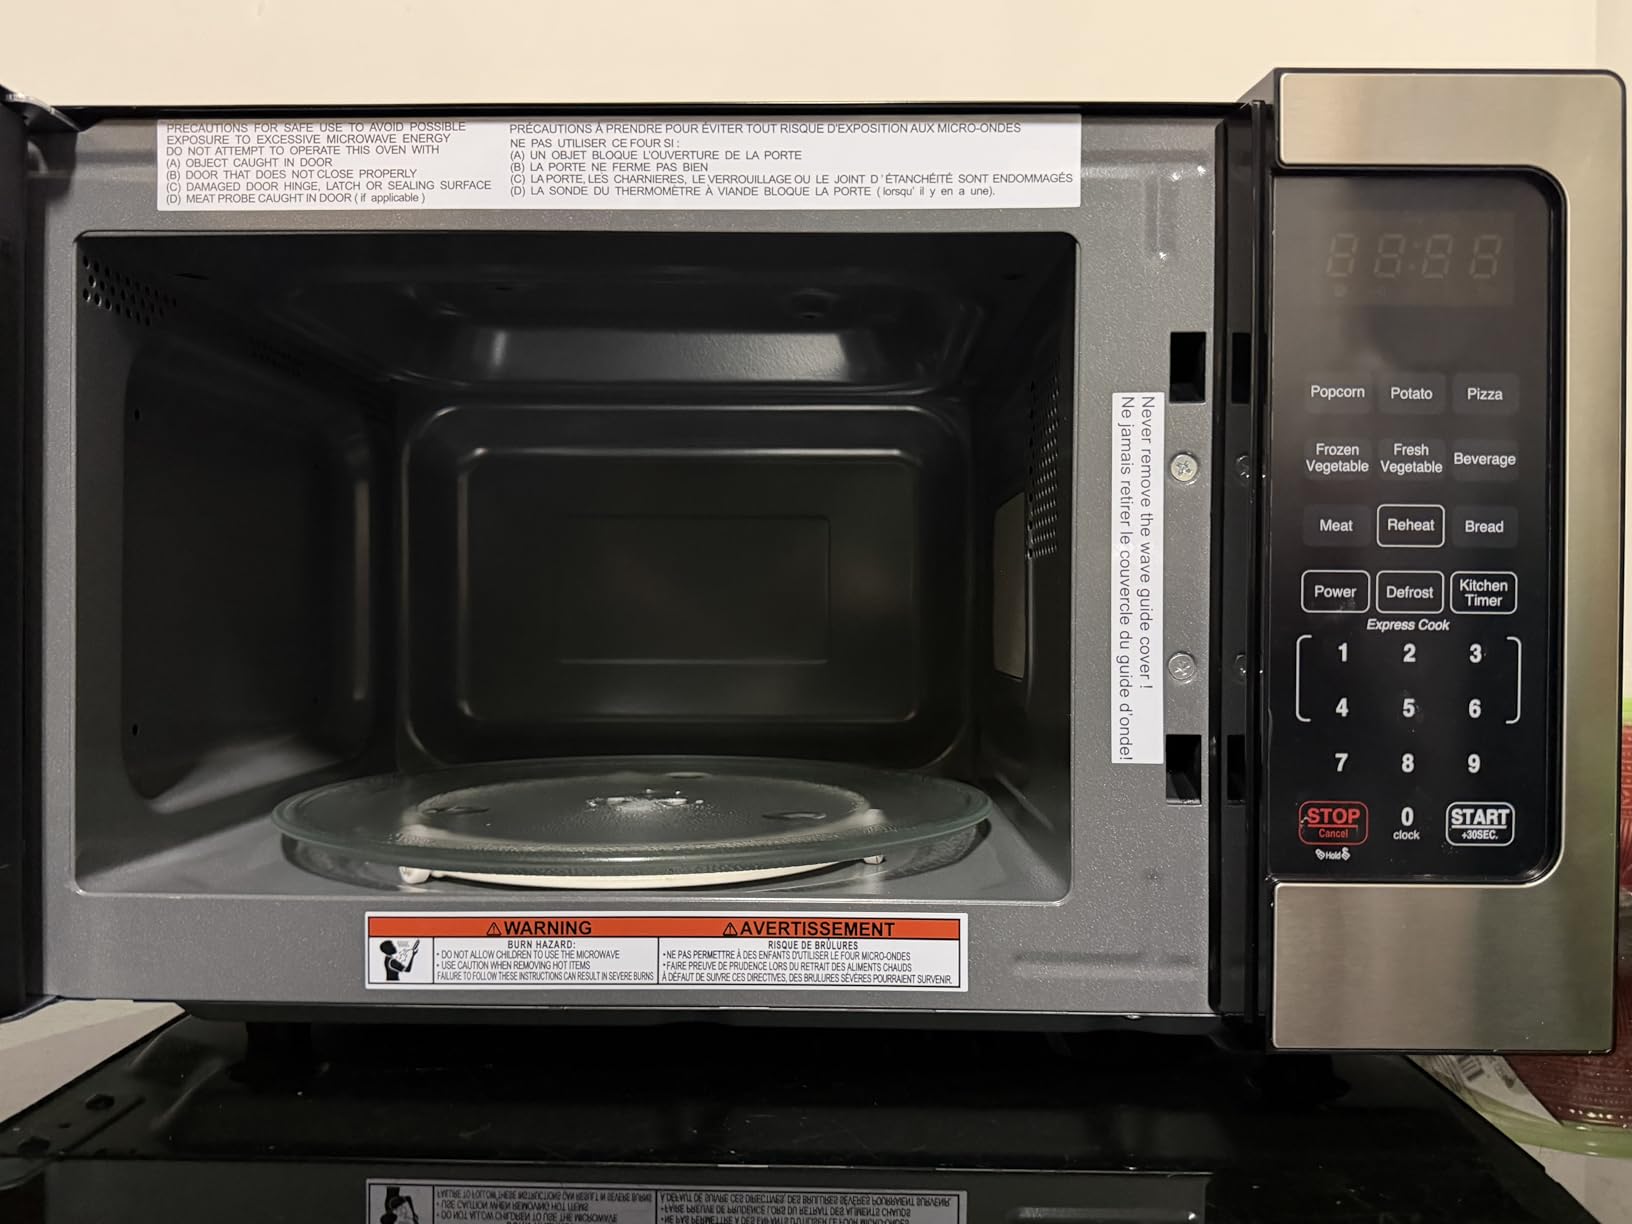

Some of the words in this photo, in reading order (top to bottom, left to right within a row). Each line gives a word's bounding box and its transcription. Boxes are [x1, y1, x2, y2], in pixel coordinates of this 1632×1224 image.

[167, 123, 248, 133] PRECAUTIONS
[254, 123, 277, 132] FOR
[284, 123, 313, 132] SAFE
[319, 122, 342, 132] USE
[349, 122, 364, 132] TO
[369, 122, 403, 132] AVOID
[409, 122, 466, 131] POSSIBLE
[509, 122, 592, 133] PRÉCAUTIONS
[595, 122, 602, 133] À
[605, 124, 662, 133] PRENDRE
[665, 124, 698, 133] POUR
[701, 122, 742, 133] ÉVITER
[746, 124, 776, 133] TOUT
[779, 123, 823, 133] RISQUE
[827, 123, 907, 133] D'EXPOSITION
[910, 123, 934, 133] AUX
[937, 123, 1021, 133] MICRO-ONDES
[167, 135, 229, 144] EXPOSURE
[235, 135, 250, 144] TO
[256, 134, 320, 144] EXCESSIVE
[326, 134, 396, 143] MICROWAVE
[402, 133, 451, 143] ENERGY
[510, 138, 525, 148] NE
[530, 138, 552, 148] PAS
[557, 138, 606, 148] UTILISER
[611, 138, 627, 148] CE
[629, 138, 661, 148] FOUR
[166, 147, 182, 155] DO
[187, 146, 210, 155] NOT
[214, 146, 264, 155] ATTEMPT
[269, 146, 284, 155] TO
[289, 146, 340, 155] OPERATE
[345, 145, 370, 154] THIS
[375, 145, 406, 154] OVEN
[411, 145, 440, 154] WITH
[510, 150, 524, 161] (A)
[530, 150, 546, 160] UN
[551, 150, 586, 160] OBJET
[591, 150, 637, 160] BLOQUE
[642, 150, 719, 160] L'OUVERTURE
[724, 150, 740, 160] DE
[745, 150, 759, 160] LA
[763, 150, 802, 160] PORTE
[166, 158, 180, 168] (A)
[185, 158, 227, 168] OBJECT
[233, 158, 278, 168] CAUGHT
[283, 158, 294, 167] IN
[299, 158, 333, 167] DOOR
[510, 163, 525, 172] (B)
[529, 163, 543, 172] LA
[548, 163, 585, 172] PORTE
[591, 163, 606, 172] NE
[612, 163, 650, 172] FERME
[656, 163, 677, 172] PAS
[682, 163, 708, 172] BIEN
[166, 170, 180, 180] (B)
[185, 170, 218, 180] DOOR
[223, 170, 250, 179] THAT
[255, 169, 286, 179] DOES
[291, 169, 314, 179] NOT
[316, 169, 353, 179] CLOSE
[358, 169, 417, 179] PROPERLY
[166, 182, 181, 192] (C)
[186, 181, 240, 192] DAMAGED
[245, 181, 278, 191] DOOR
[283, 181, 320, 191] HINGE,
[325, 181, 360, 191] LATCH
[365, 181, 382, 191] OR
[387, 180, 434, 190] SEALING
[440, 180, 492, 190] SURFACE
[1311, 385, 1365, 401] Popcorn
[1391, 386, 1433, 400] Potato
[1467, 387, 1503, 400] Pizza
[1121, 397, 1135, 419] Ne
[1141, 396, 1155, 444] Never
[1117, 422, 1134, 475] jamais
[1316, 443, 1359, 456] Frozen
[1394, 443, 1429, 456] Fresh
[1306, 459, 1369, 475] Vegetable
[1454, 452, 1516, 468] Beverage
[1380, 460, 1443, 475] Vegetable
[1140, 449, 1151, 507] remove
[1120, 480, 1134, 527] retirer
[1140, 512, 1154, 537] the
[1320, 519, 1353, 532] Meat
[1388, 518, 1435, 531] Reheat
[1465, 520, 1504, 533] Bread
[1119, 531, 1134, 545] le
[1139, 542, 1151, 583] wave
[1119, 550, 1133, 625] couvercle
[1314, 585, 1357, 598] Power
[1386, 585, 1434, 599] Defrost
[1460, 578, 1508, 592] Kitchen
[1464, 593, 1503, 607] Timer
[1137, 588, 1154, 631] guide
[1366, 618, 1415, 633] Express
[1418, 618, 1450, 631] Cook
[1119, 630, 1133, 649] du
[1139, 636, 1150, 680] cover
[1338, 642, 1347, 662] 1
[1403, 643, 1416, 663] 2
[1469, 643, 1482, 663] 3
[1116, 655, 1133, 698] guide
[1335, 697, 1349, 717] 4
[1402, 698, 1415, 718] 5
[1469, 698, 1481, 718] 6
[1119, 703, 1133, 760] d'onde!
[1335, 753, 1348, 772] 7
[1401, 753, 1414, 773] 8
[1468, 754, 1481, 773] 9
[1307, 808, 1361, 824] STOP
[1401, 806, 1414, 826] 0
[1451, 809, 1510, 825] START
[1318, 828, 1348, 838] Cancel
[1393, 829, 1420, 840] clock
[1325, 851, 1341, 860] Hold
[504, 921, 592, 935] WARNING
[740, 921, 895, 937] AVERTISSEMENT
[507, 941, 532, 949] BURN
[535, 941, 575, 949] HAZARD:
[768, 941, 798, 950] RISQUE
[801, 941, 811, 950] DE
[441, 950, 452, 959] DO
[453, 950, 469, 959] NOT
[469, 950, 494, 959] ALLOW
[495, 950, 532, 959] CHILDREN
[532, 950, 543, 959] TO
[544, 950, 559, 959] USE
[559, 950, 574, 959] THE
[576, 950, 620, 959] MICROWAVE
[666, 950, 676, 959] NE
[677, 950, 691, 959] PAS
[692, 950, 735, 960] PERMETTRE
[742, 951, 757, 960] DES
[758, 951, 790, 960] ENFANTS
[830, 951, 838, 960] LE
[840, 951, 860, 960] FOUR
[441, 961, 455, 970] USE
[457, 961, 489, 970] CAUTION
[490, 961, 512, 970] WHEN
[513, 961, 551, 970] REMOVING
[552, 961, 568, 970] HOT
[568, 961, 591, 970] ITEMS
